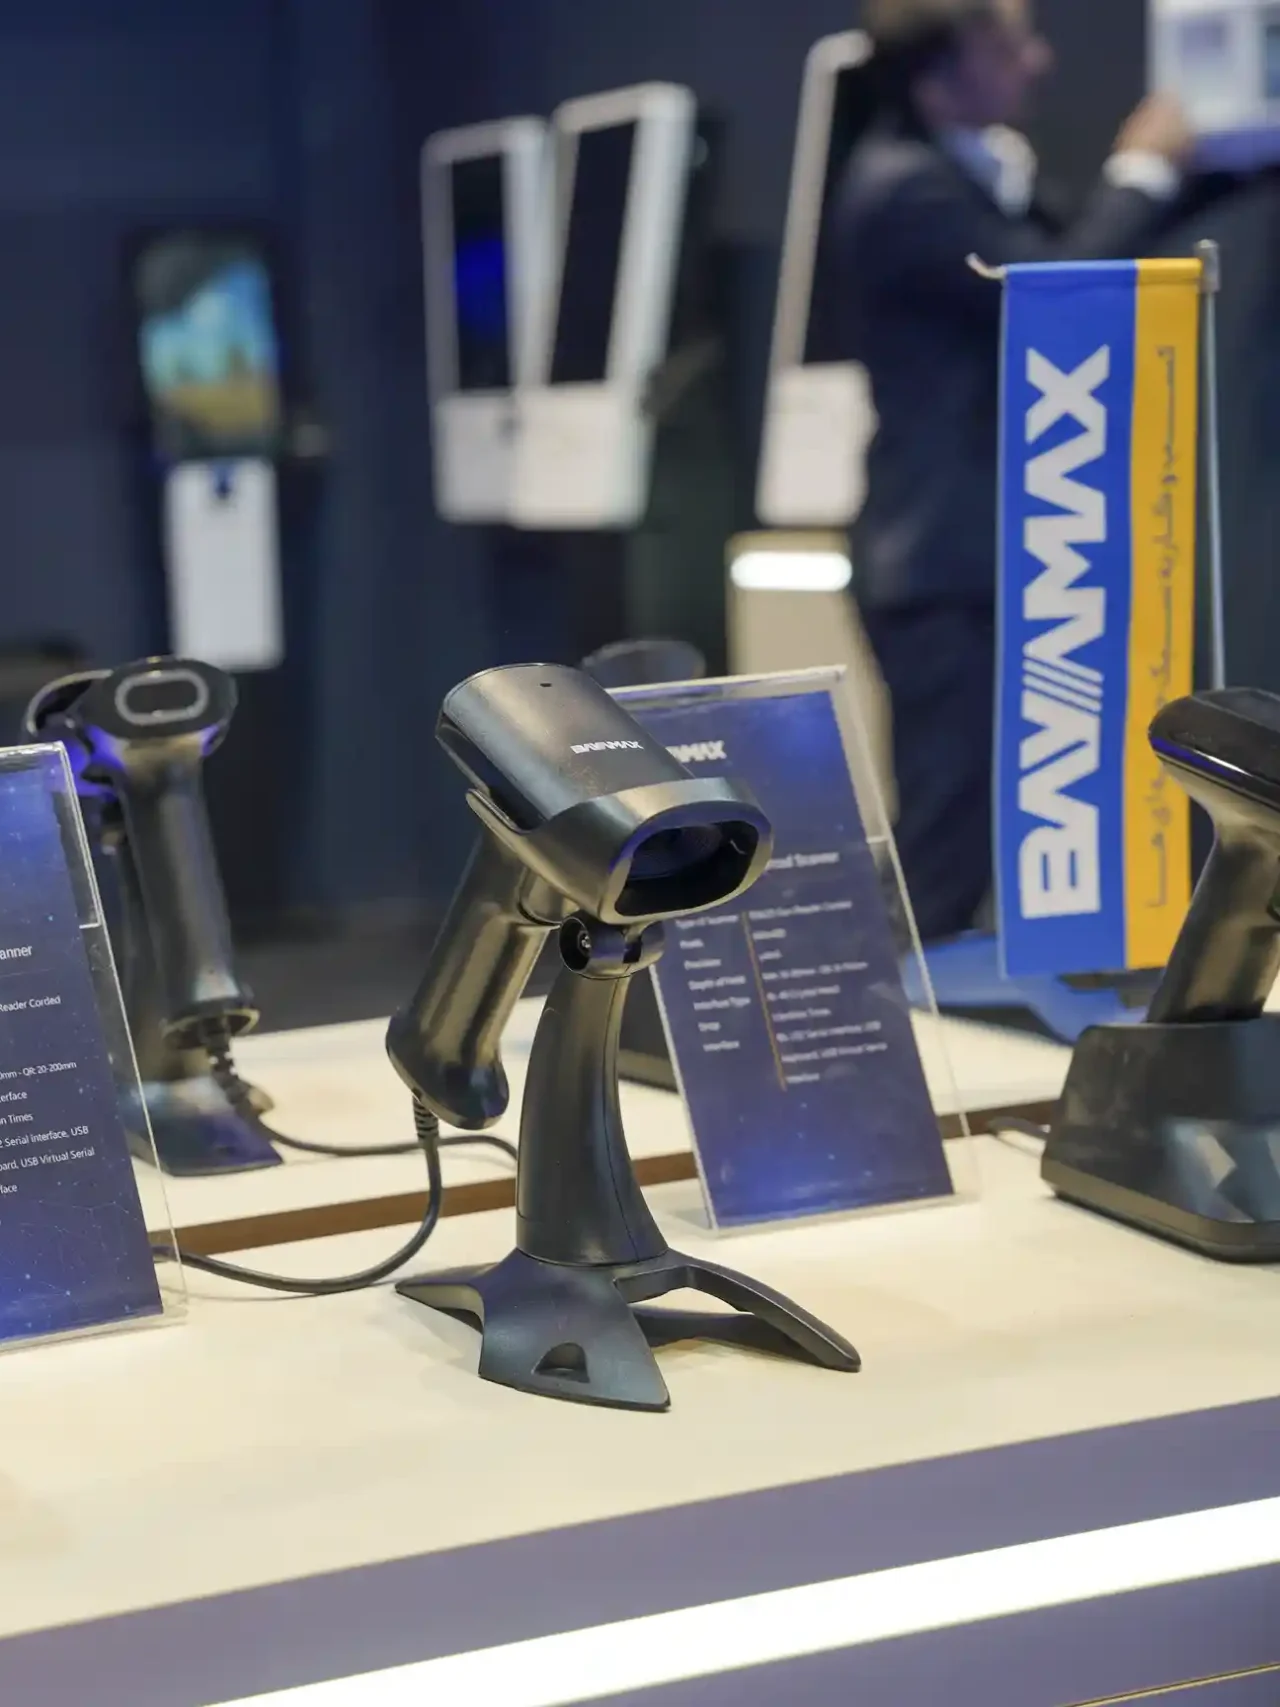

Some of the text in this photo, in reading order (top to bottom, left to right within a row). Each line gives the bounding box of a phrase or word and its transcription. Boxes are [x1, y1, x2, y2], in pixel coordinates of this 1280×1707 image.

[28, 995, 61, 1008] Corded
[8, 1112, 33, 1123] Times
[4, 1135, 29, 1148] Serial
[30, 1129, 70, 1143] interface,
[71, 1125, 89, 1136] USB
[20, 1156, 39, 1168] USB
[40, 1152, 68, 1164] Virtual
[70, 1147, 95, 1159] Serial
